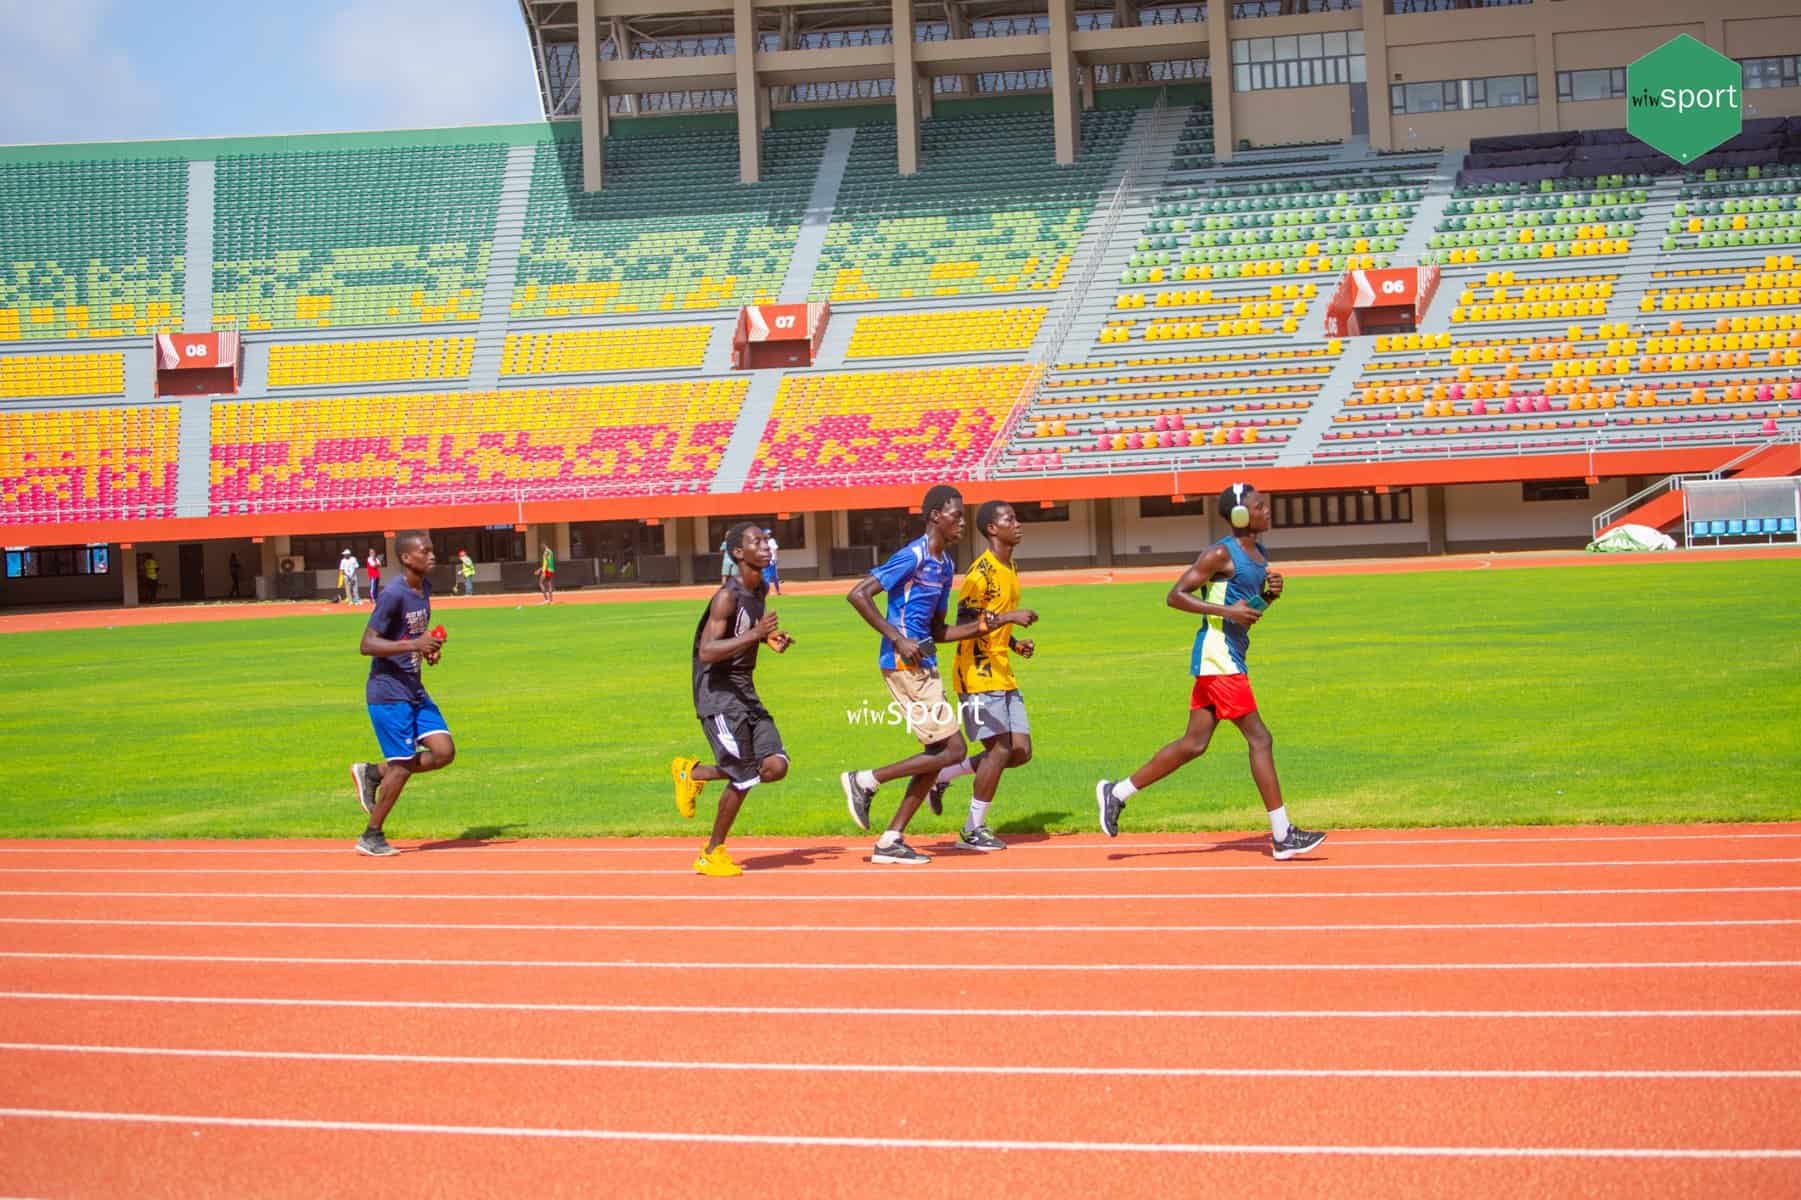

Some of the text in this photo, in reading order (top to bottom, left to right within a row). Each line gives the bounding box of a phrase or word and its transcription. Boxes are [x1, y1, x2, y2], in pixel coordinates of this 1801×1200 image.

[1382, 279, 1405, 294] 06
[775, 315, 796, 329] 07
[185, 343, 208, 357] 08
